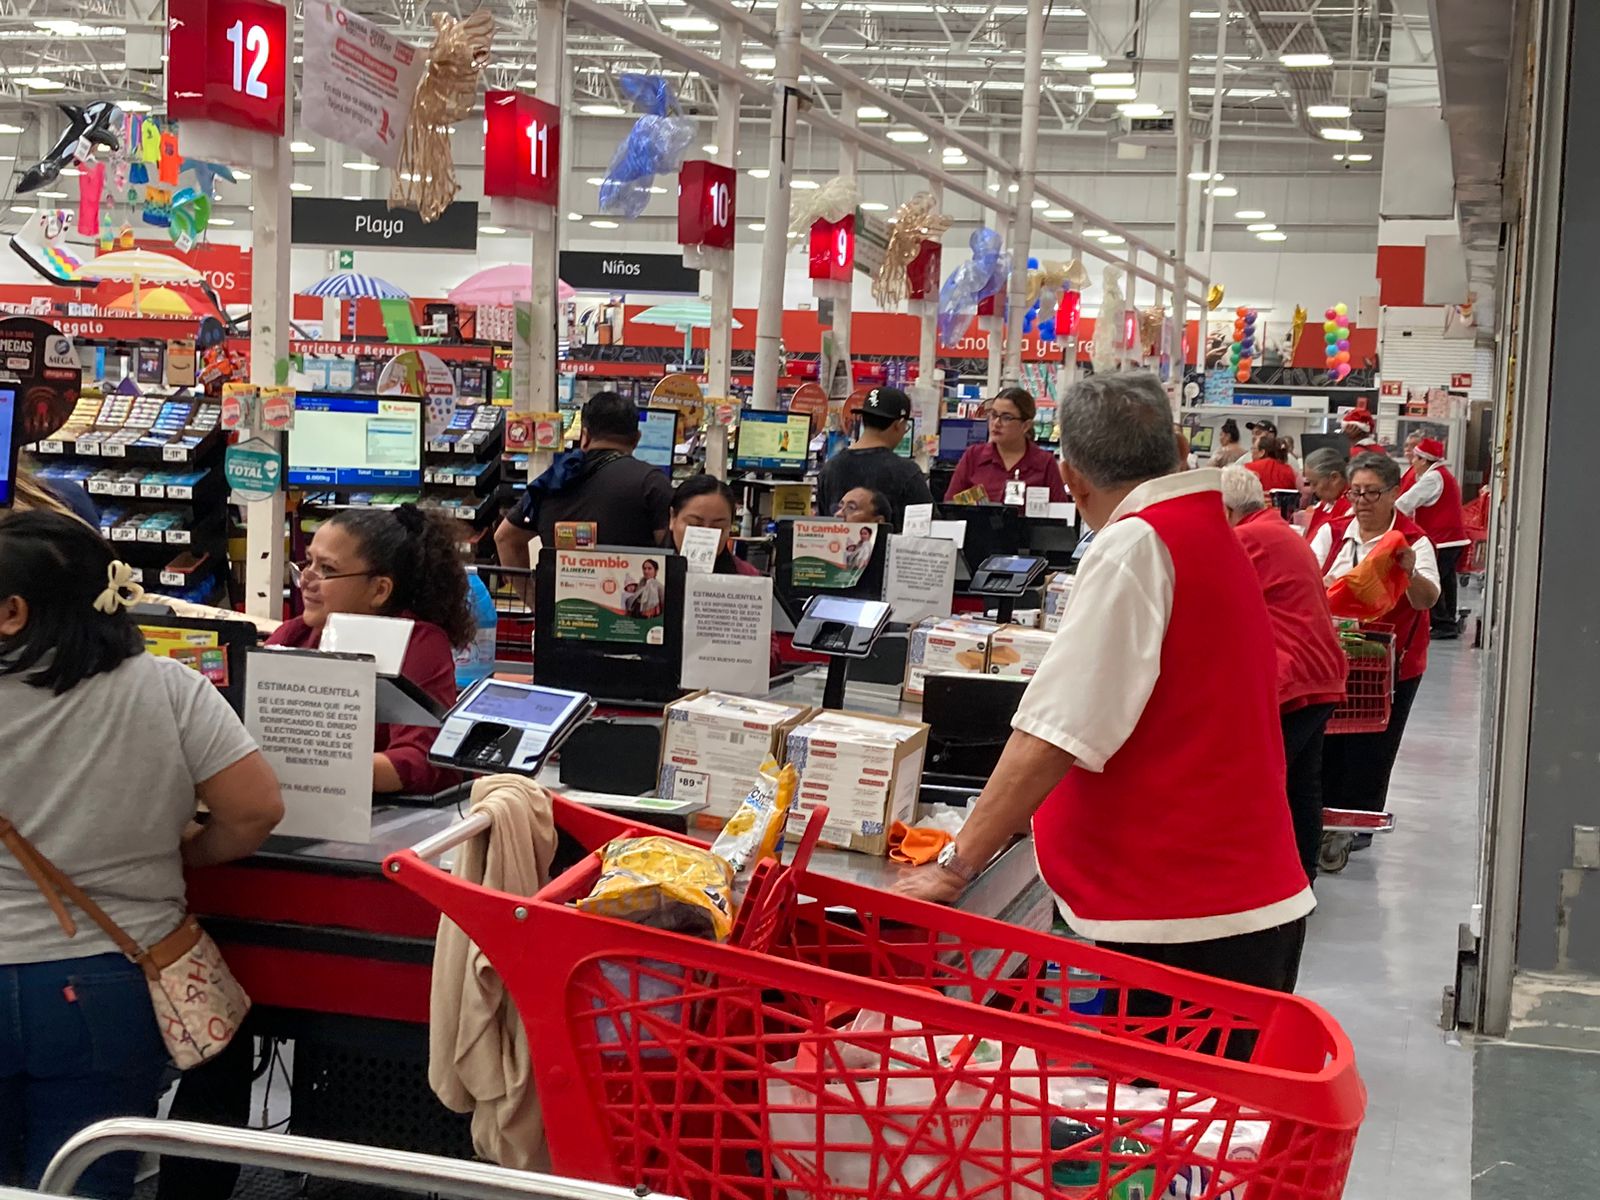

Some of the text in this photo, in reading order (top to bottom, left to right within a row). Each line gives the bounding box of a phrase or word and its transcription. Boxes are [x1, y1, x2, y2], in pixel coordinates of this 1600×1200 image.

[227, 19, 270, 99] 12
[526, 119, 548, 178] 11
[711, 181, 729, 228] 10
[355, 215, 404, 238] Playa
[837, 228, 848, 267] 9
[602, 260, 641, 276] Niños
[53, 320, 104, 337] Regalo
[294, 343, 406, 359] Tarjetas de Regalo
[49, 355, 74, 366] MEGA
[560, 361, 596, 377] Regalo
[1242, 398, 1273, 406] PHILIPS
[229, 464, 263, 478] TOTAL
[796, 524, 850, 535] Tu cambio
[560, 554, 629, 569] Tu cambio
[693, 591, 762, 601] ESTIMADA CLIENTELA
[257, 681, 360, 698] ESTIMADA CLIENTELA
[257, 697, 361, 712] SE LES INFORMA QUE POR
[271, 708, 312, 718] MOMENTO
[313, 711, 325, 719] NO
[325, 712, 336, 720] SE
[338, 713, 358, 721] ESTA
[259, 716, 314, 728] BONIFICANDO
[327, 721, 357, 731] DINERO
[264, 726, 352, 740] ELECTRONICO DE LAS
[262, 735, 353, 750] TARJETAS DE VALES DE
[262, 744, 353, 760] DESPENSA Y TARJETAS
[285, 757, 329, 767] BIENESTAR
[294, 784, 321, 793] NUEVO
